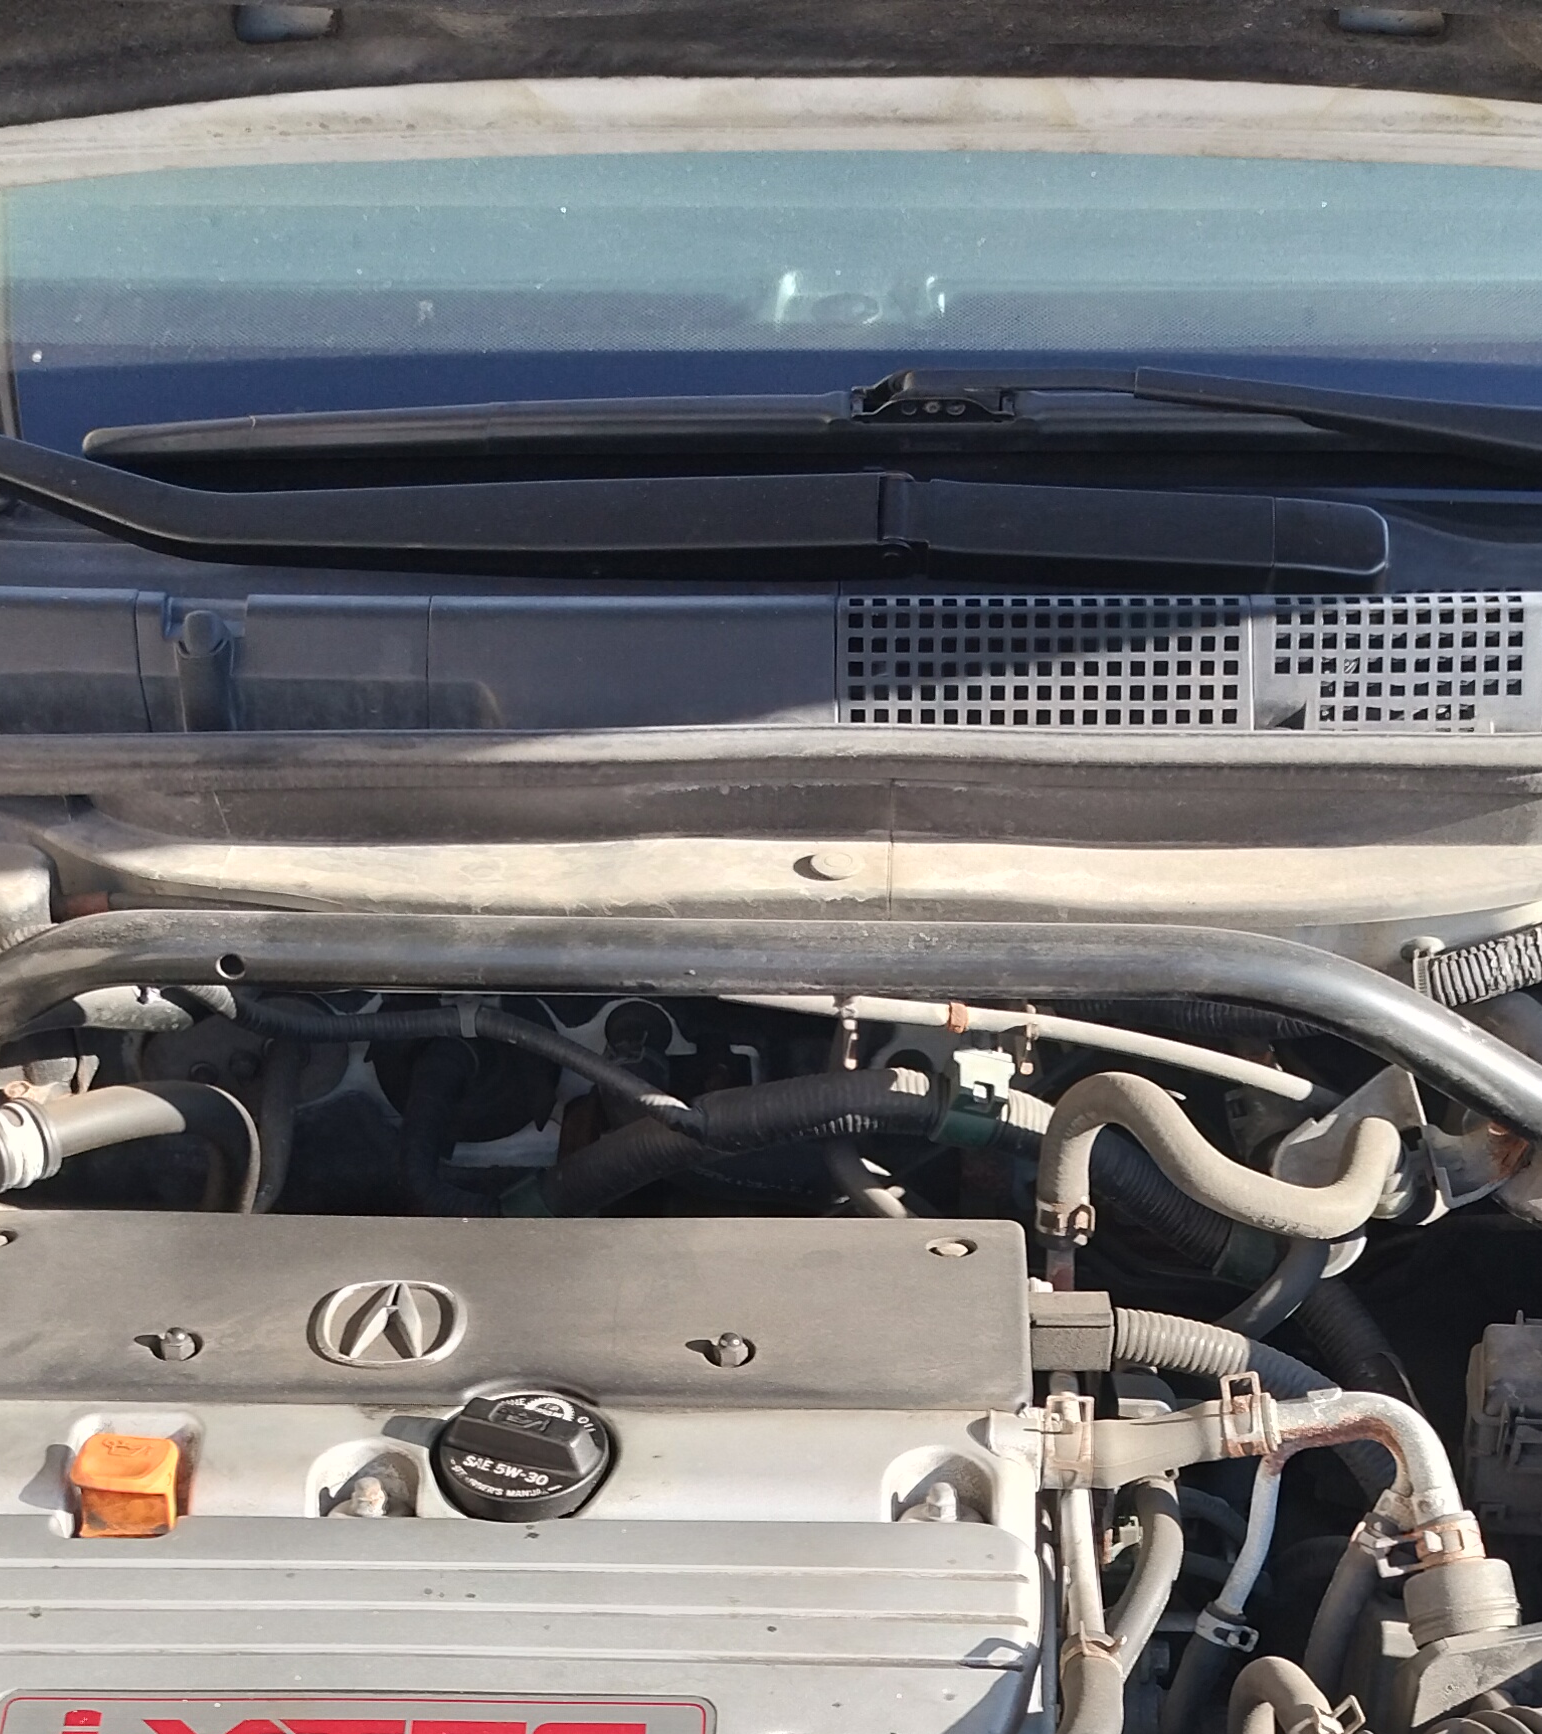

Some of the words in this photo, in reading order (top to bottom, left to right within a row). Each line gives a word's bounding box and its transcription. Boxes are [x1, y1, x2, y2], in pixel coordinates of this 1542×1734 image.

[577, 1416, 597, 1433] OIL
[462, 1455, 493, 1472] SAE
[493, 1464, 549, 1486] 5W-30
